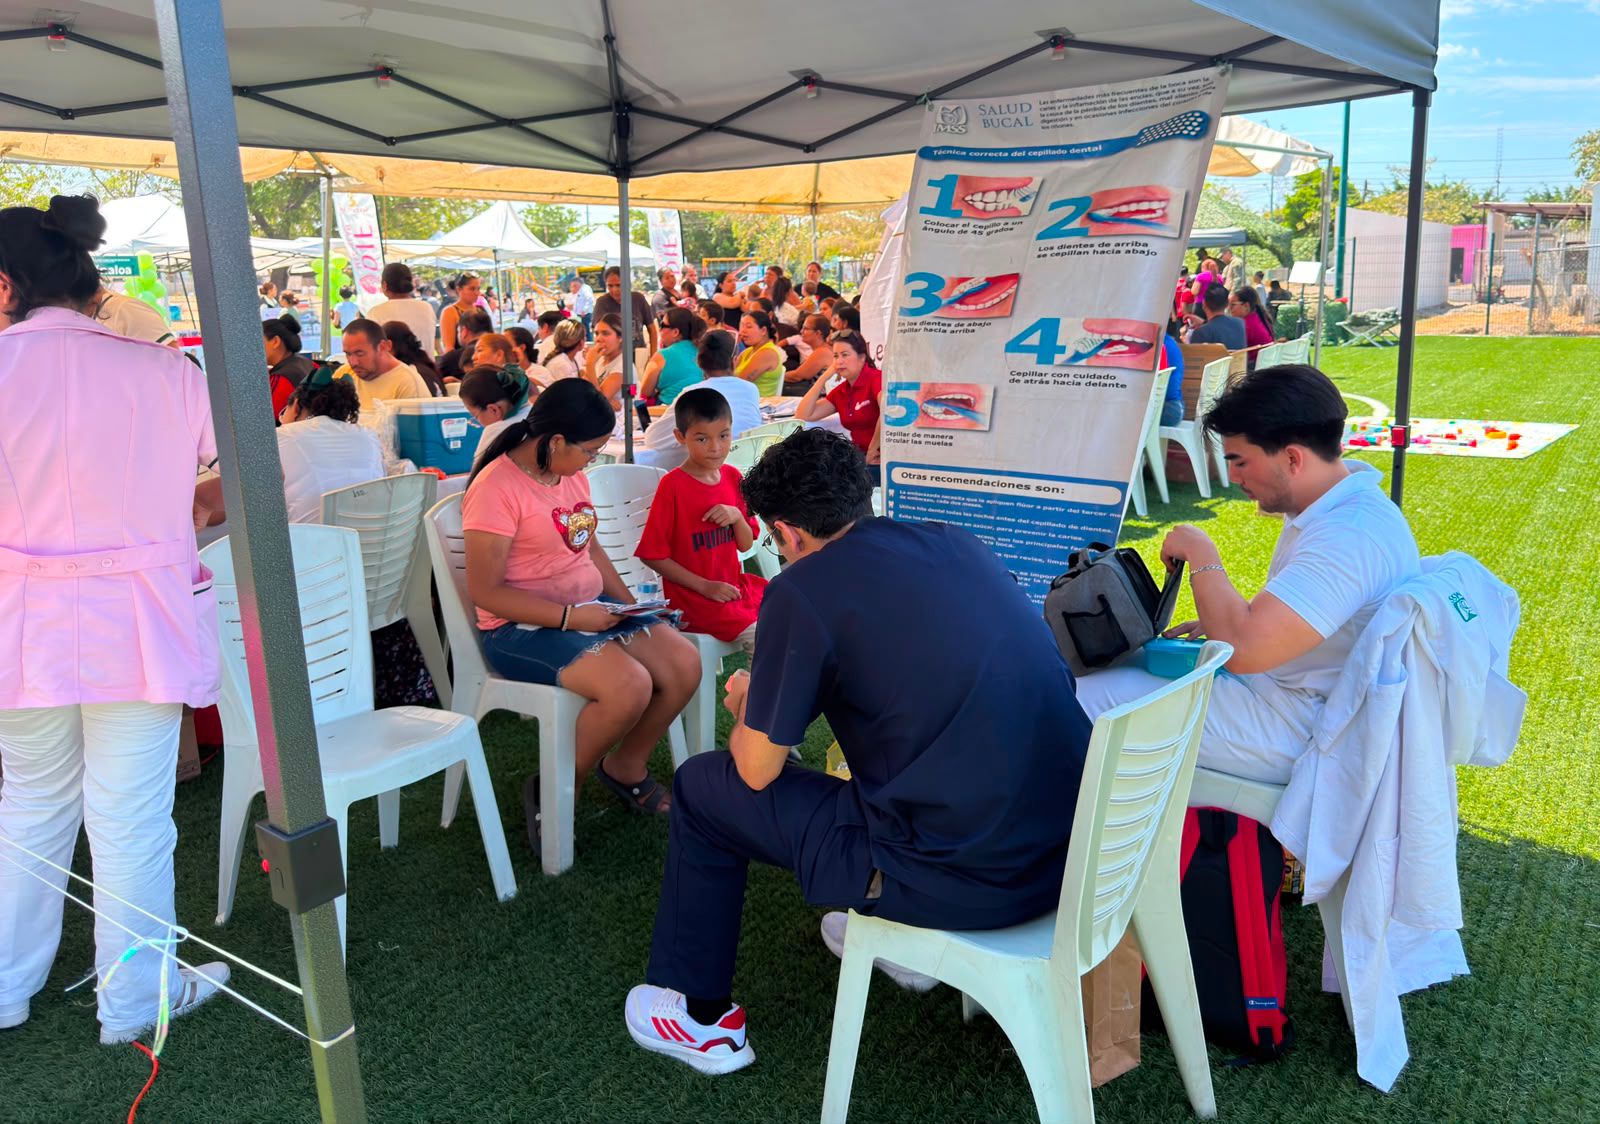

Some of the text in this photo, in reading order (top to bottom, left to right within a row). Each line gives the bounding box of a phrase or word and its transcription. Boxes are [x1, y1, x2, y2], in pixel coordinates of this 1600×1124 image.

[978, 102, 1032, 116] SALUD
[983, 116, 1034, 128] BUCAL
[1070, 145, 1102, 154] dental
[919, 174, 962, 218] 1
[922, 225, 955, 234] ángulo
[986, 227, 1014, 236] grados
[1036, 196, 1093, 241] 2
[899, 272, 946, 317] 3
[1004, 318, 1066, 365] 4
[884, 382, 921, 427] 5
[901, 472, 927, 480] Otras
[930, 475, 1031, 490] recomendaciones
